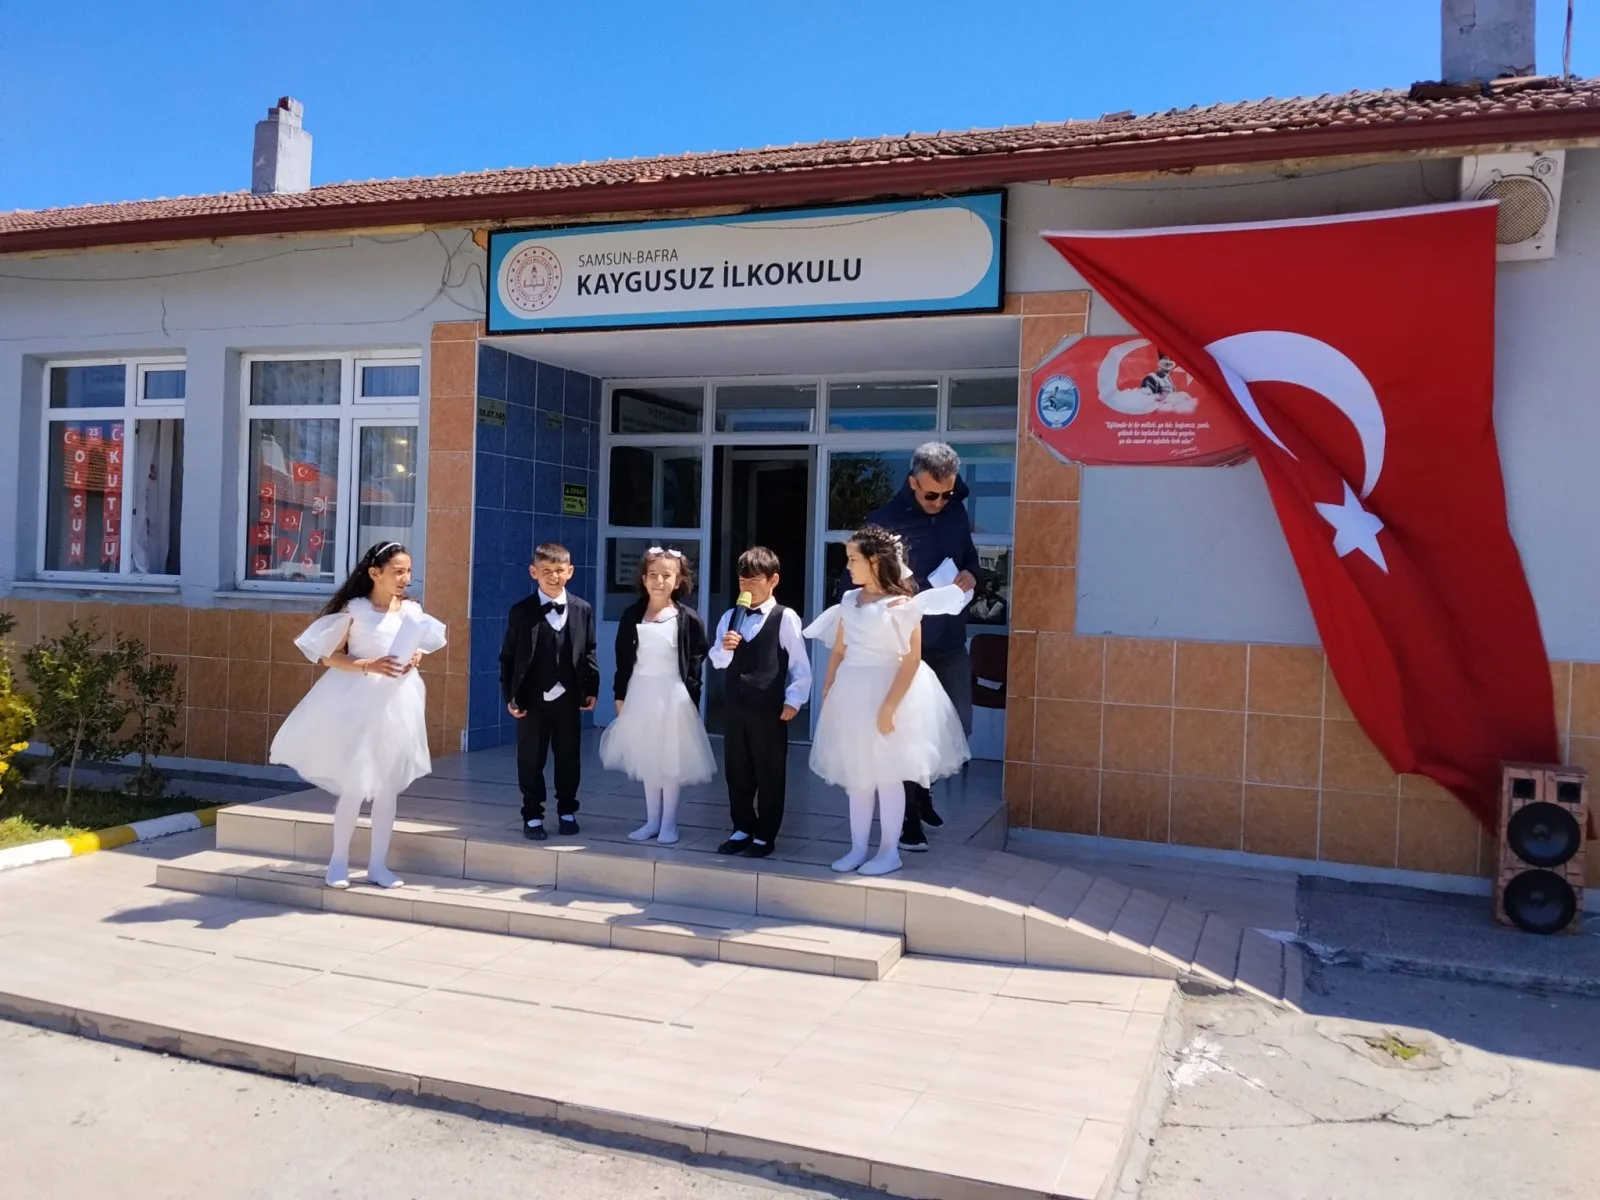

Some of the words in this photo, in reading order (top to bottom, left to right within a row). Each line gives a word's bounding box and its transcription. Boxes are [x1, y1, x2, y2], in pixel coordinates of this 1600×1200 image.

[577, 266, 715, 296] KAYGUSUZ
[723, 258, 861, 288] İLKOKULU
[578, 248, 679, 268] SAMSUN-BAFRA
[71, 450, 85, 556] OLSUN
[105, 450, 120, 556] KUTLU
